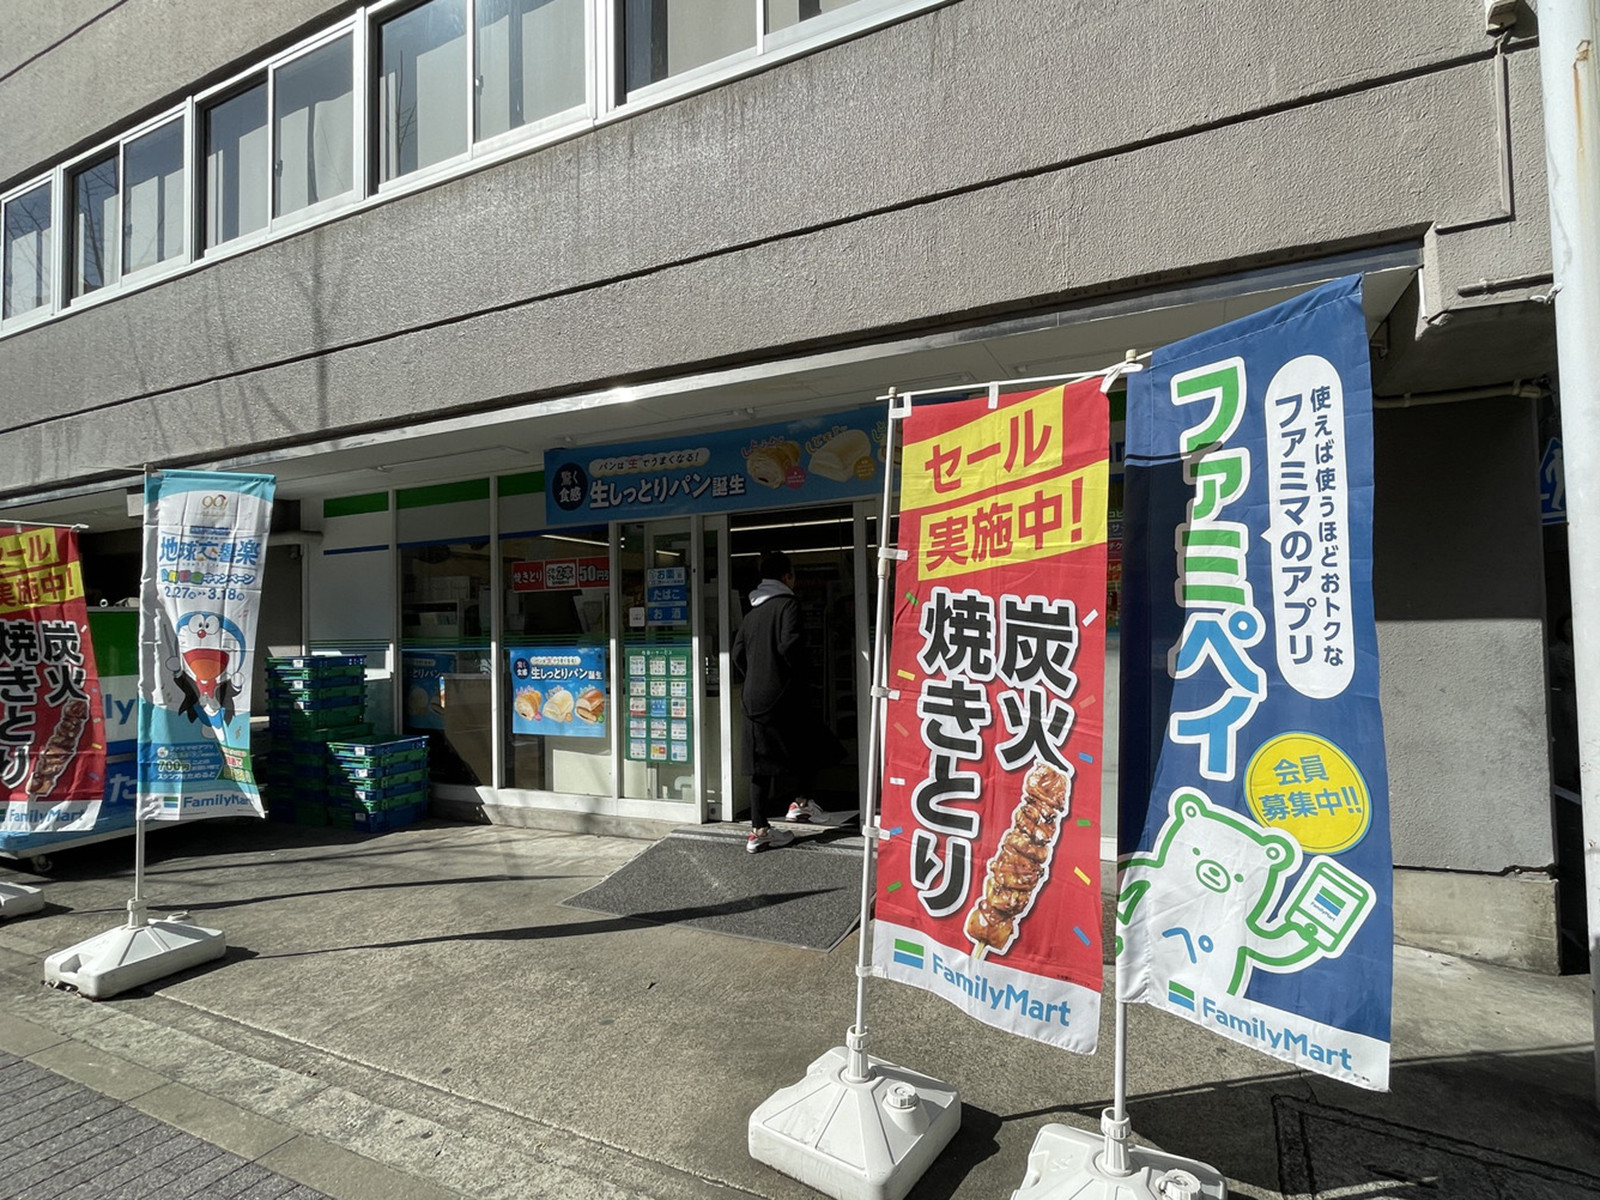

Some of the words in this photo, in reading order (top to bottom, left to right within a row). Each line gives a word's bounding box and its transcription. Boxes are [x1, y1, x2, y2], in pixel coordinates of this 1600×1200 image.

[924, 408, 1052, 494] セール
[0, 534, 50, 568] ール
[925, 476, 1084, 572] 実施中!
[1275, 393, 1317, 665] ファミマのアプリ
[1310, 386, 1344, 666] 使えば使うほどおトクな
[653, 589, 680, 600] たばこ
[1171, 358, 1265, 779] ファミペイ
[41, 620, 88, 704] 炭火
[999, 596, 1077, 774] 炭火
[912, 589, 994, 916] 焼きとり
[1273, 755, 1329, 786] 会員
[932, 952, 1071, 1027] FamilyMart
[1203, 996, 1353, 1071] FamilyMart
